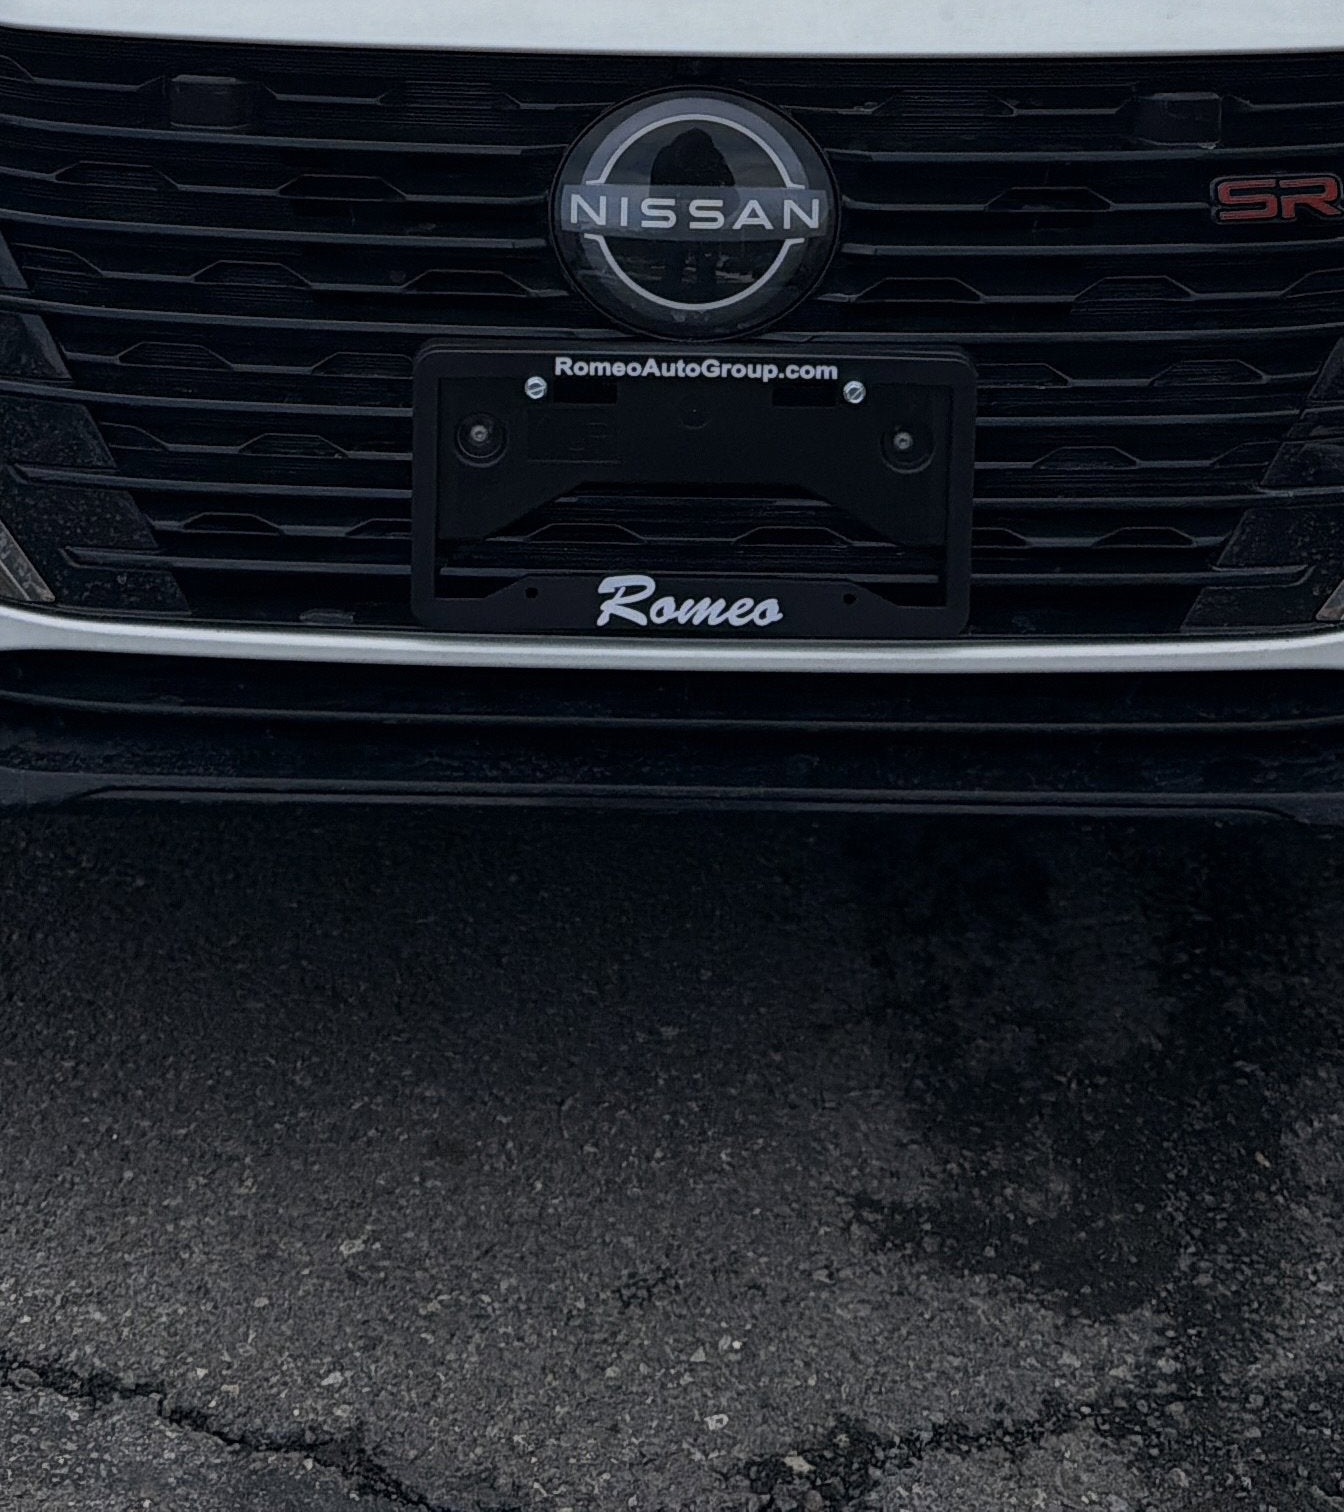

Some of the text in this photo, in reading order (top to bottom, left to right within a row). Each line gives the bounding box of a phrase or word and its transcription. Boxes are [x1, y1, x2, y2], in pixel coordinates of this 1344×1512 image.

[570, 193, 820, 230] NISSAN
[1217, 177, 1342, 220] SR
[554, 356, 838, 383] RomeoAutoGroup.com
[596, 574, 784, 627] Romeo
